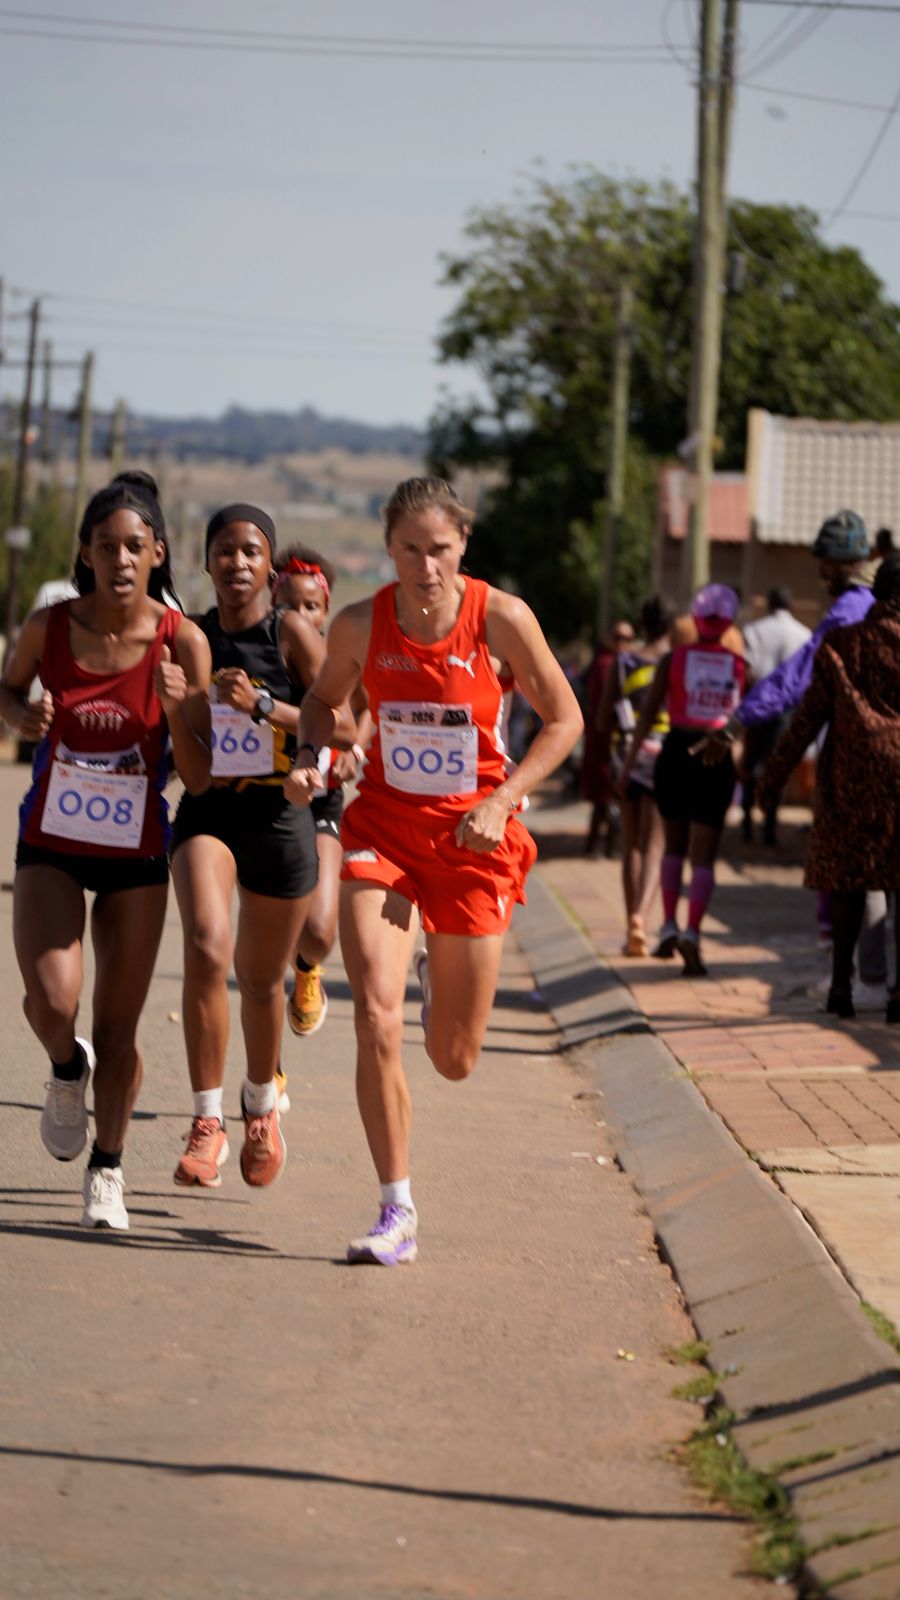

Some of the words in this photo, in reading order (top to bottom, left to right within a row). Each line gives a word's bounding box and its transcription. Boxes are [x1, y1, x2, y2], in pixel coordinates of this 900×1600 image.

[211, 728, 260, 754] 66
[391, 746, 465, 775] 005
[58, 790, 133, 825] 008
